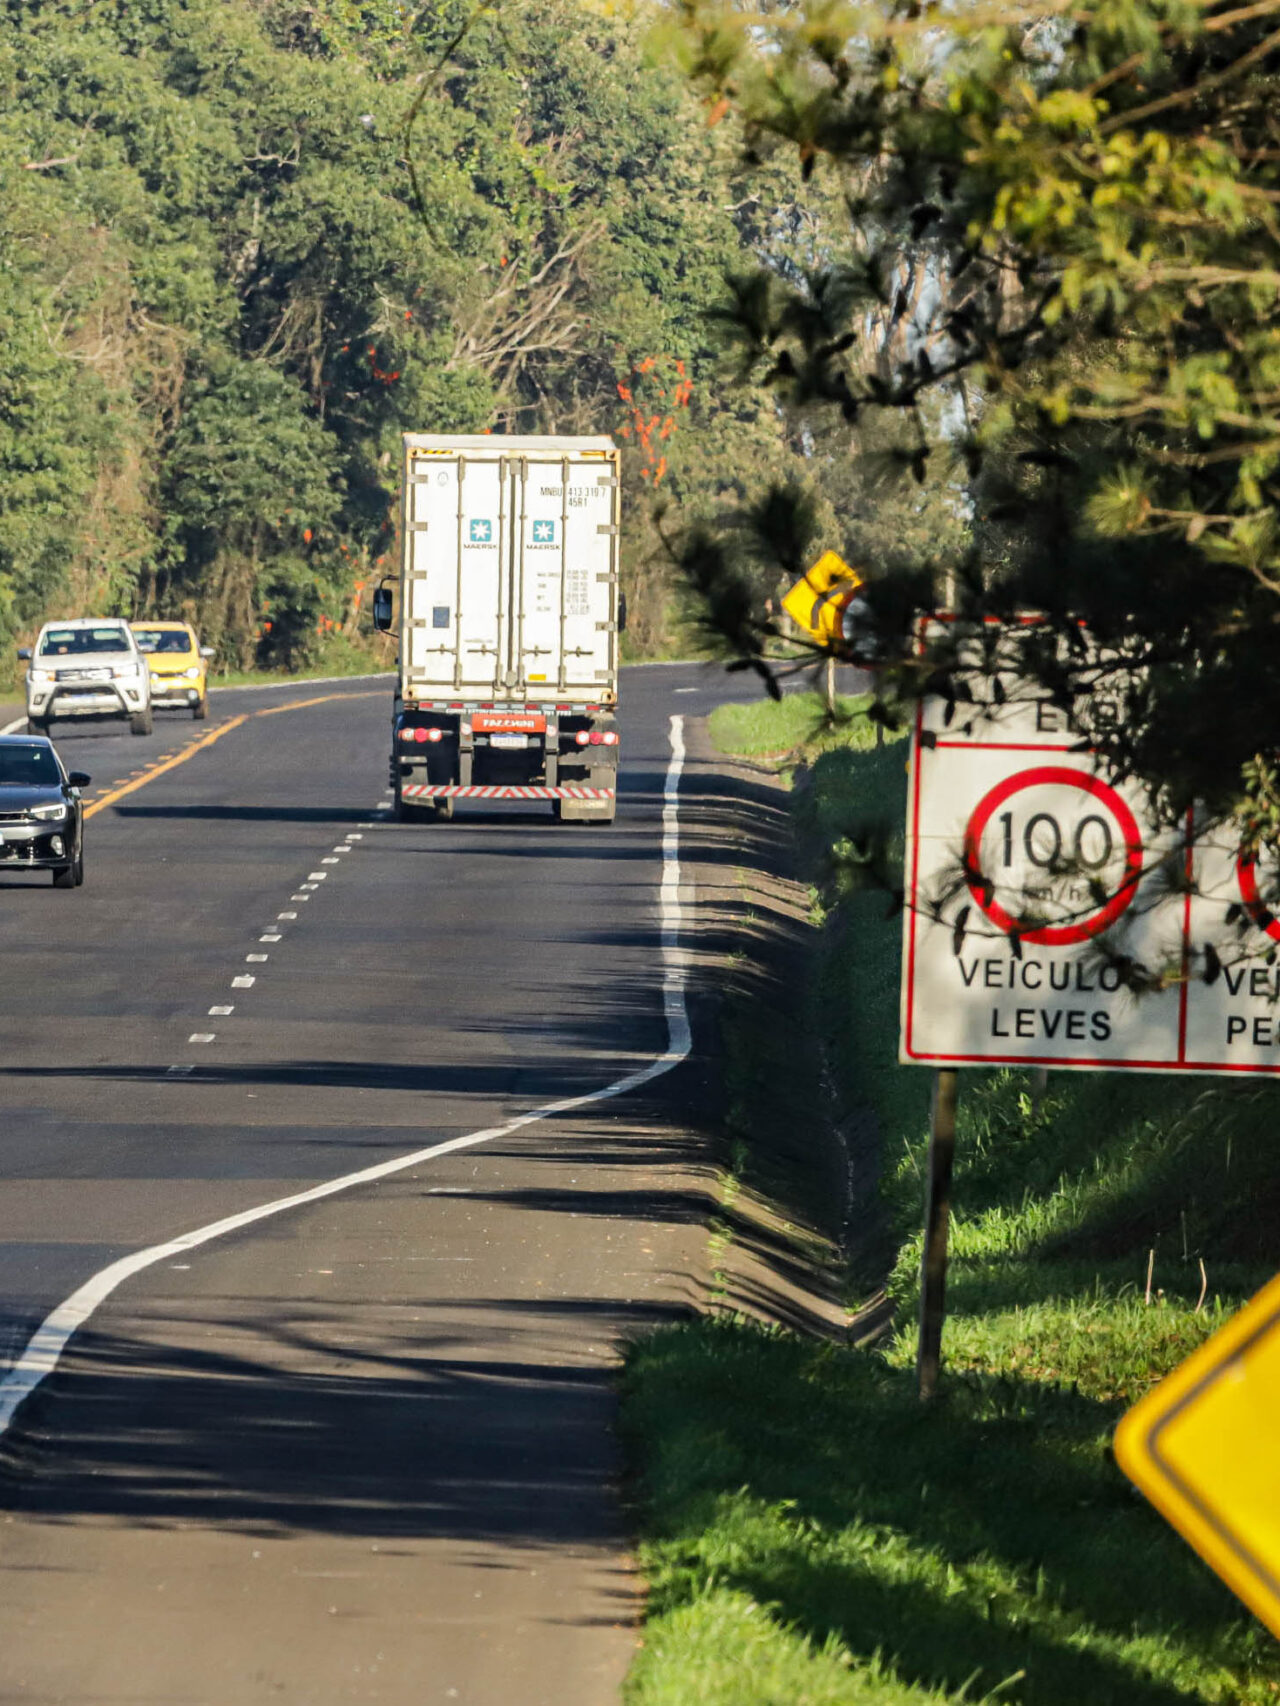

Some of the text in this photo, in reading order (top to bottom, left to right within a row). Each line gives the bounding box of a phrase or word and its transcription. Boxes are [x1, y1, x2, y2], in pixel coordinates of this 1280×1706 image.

[999, 812, 1113, 871] 100
[959, 952, 1147, 993] VEÍCULO
[991, 1008, 1112, 1041] LEVES
[1226, 1015, 1280, 1046] PE
